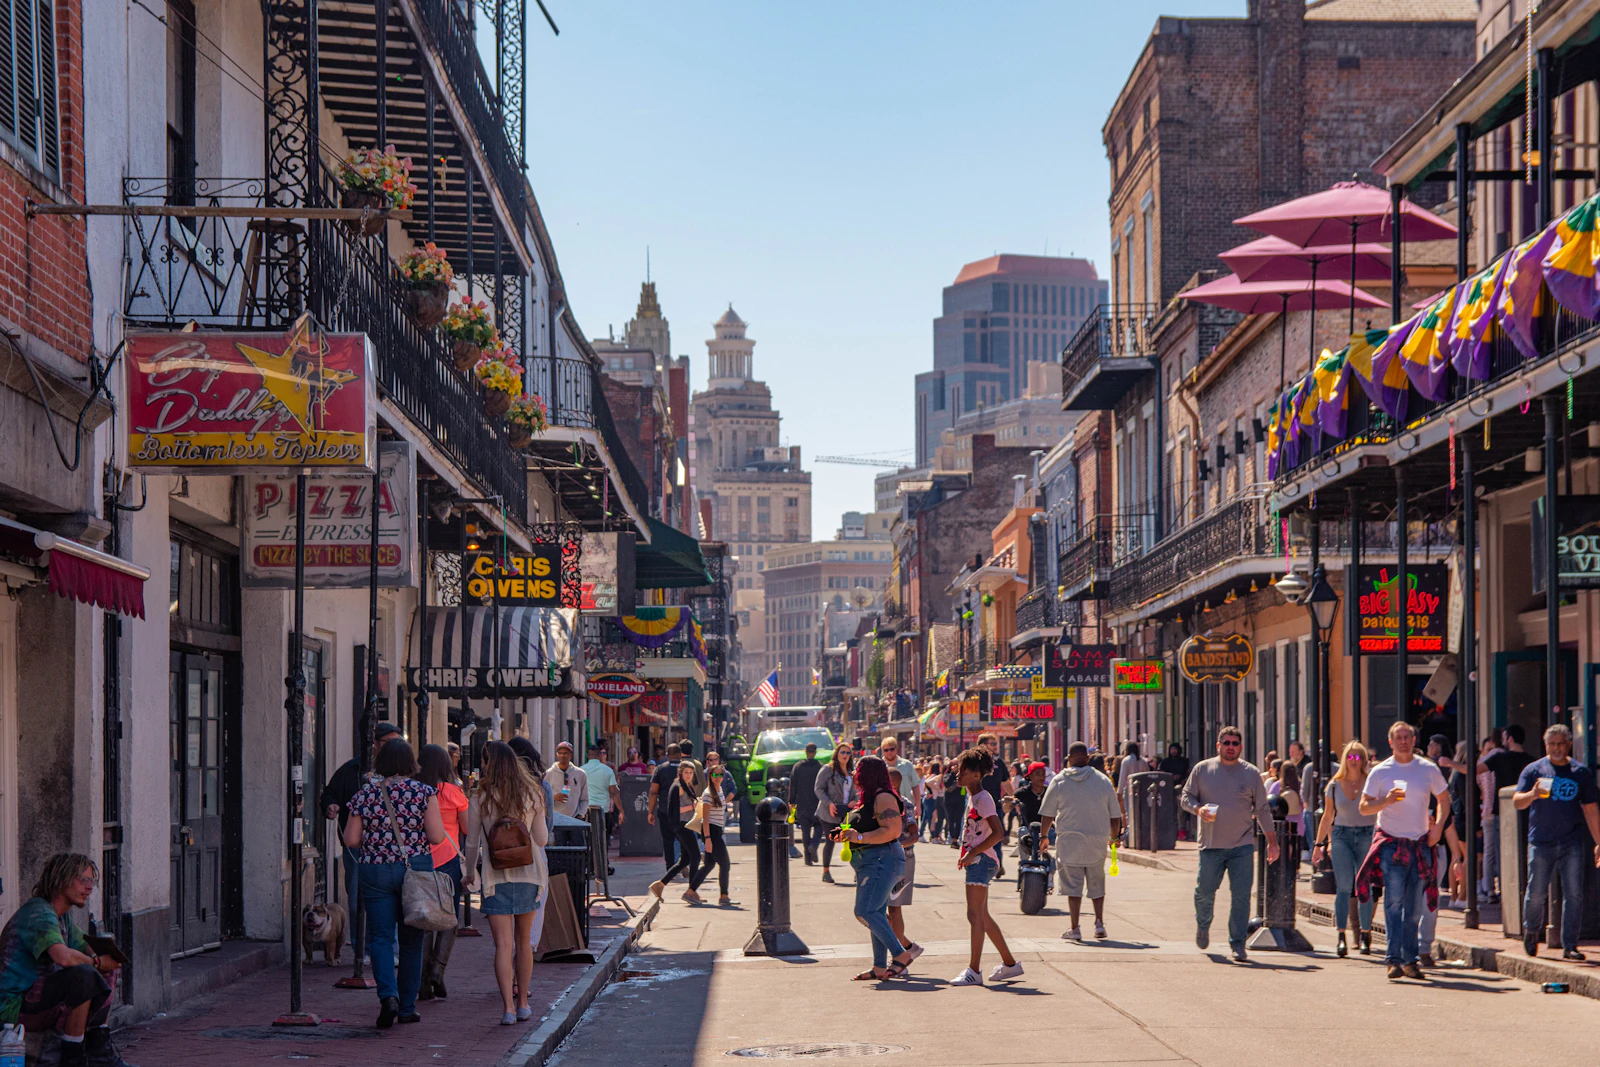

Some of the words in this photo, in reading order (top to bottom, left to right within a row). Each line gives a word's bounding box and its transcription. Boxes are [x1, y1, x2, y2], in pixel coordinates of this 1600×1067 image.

[136, 437, 267, 461] Bottomless
[271, 435, 361, 462] Topless
[255, 482, 400, 521] PIZZA
[259, 546, 296, 564] PIZZA
[303, 547, 323, 564] BY
[327, 547, 353, 564] THE
[356, 546, 396, 564] SLCE
[468, 579, 557, 599] OWENS
[1359, 589, 1391, 615] BIG
[1395, 587, 1440, 615] ASY
[1052, 659, 1111, 669] SUTR
[1186, 651, 1250, 667] BANDSTAND
[413, 668, 478, 687] CHRIS
[486, 669, 562, 686] OWENS
[587, 682, 646, 693] DIXIELAND
